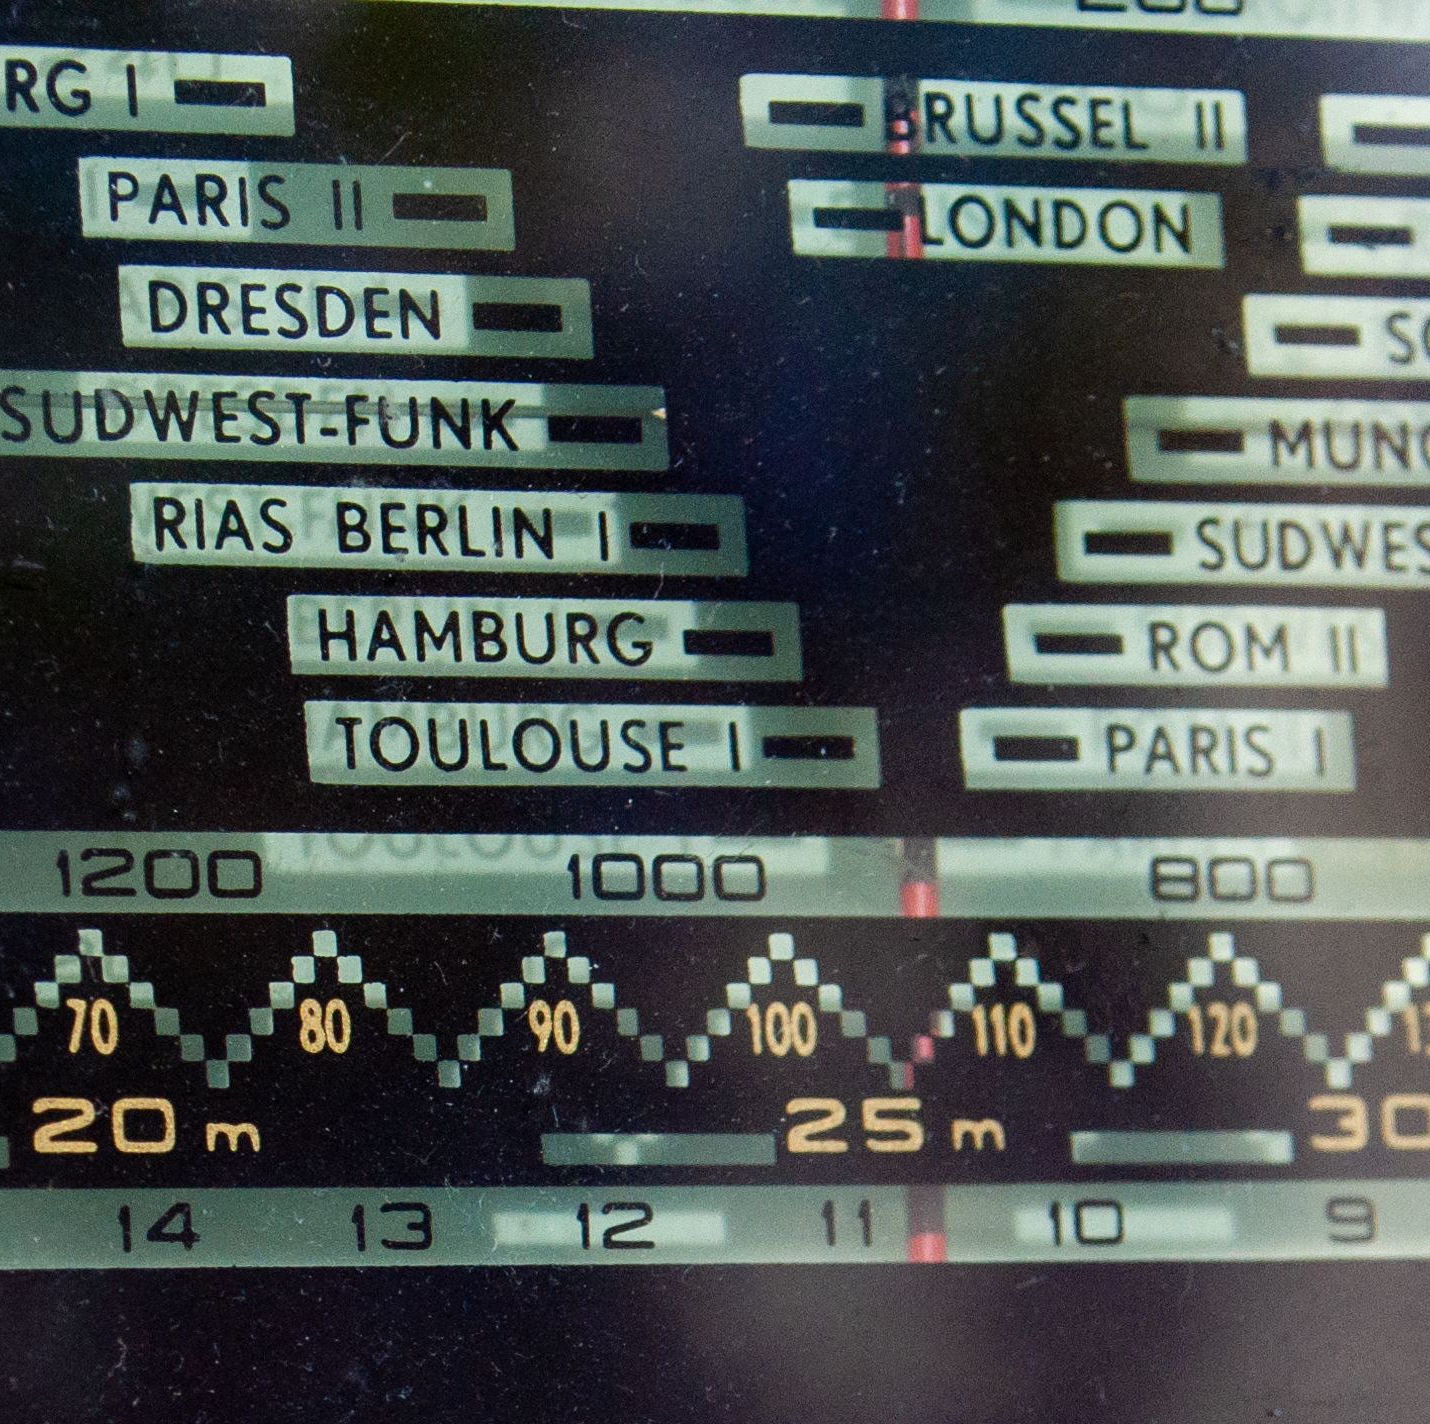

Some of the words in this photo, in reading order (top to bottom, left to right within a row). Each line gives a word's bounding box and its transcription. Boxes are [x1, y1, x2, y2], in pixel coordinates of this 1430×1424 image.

[1195, 100, 1225, 151] II
[108, 171, 291, 231] PARIS
[331, 179, 363, 231] II
[921, 193, 1192, 254] LONDON
[148, 279, 441, 342] DRESDEN
[152, 497, 293, 553] RIAS
[337, 502, 553, 560] BERLIN
[318, 609, 654, 666] HAMBURG
[1147, 622, 1290, 674] ROM
[1329, 625, 1358, 674] II
[335, 717, 687, 774] TOULOUSE
[1105, 725, 1273, 775] PARIS
[57, 849, 263, 899] 1200
[568, 854, 766, 902] 1000
[1150, 856, 1315, 902] 800
[68, 999, 118, 1055] 70
[299, 999, 351, 1054] 80
[528, 1000, 580, 1055] 90
[746, 1002, 818, 1057] 100
[971, 1003, 1036, 1058] 110
[1188, 1003, 1257, 1057] 120
[32, 1098, 176, 1154] 20
[206, 1123, 261, 1153] m
[786, 1098, 925, 1154] 25
[952, 1119, 1006, 1153] m
[119, 1202, 201, 1252] 14
[351, 1202, 433, 1252] 13
[576, 1202, 654, 1250] 12
[821, 1199, 873, 1247] 11
[1048, 1199, 1123, 1246] 10
[1326, 1197, 1375, 1244] 9
